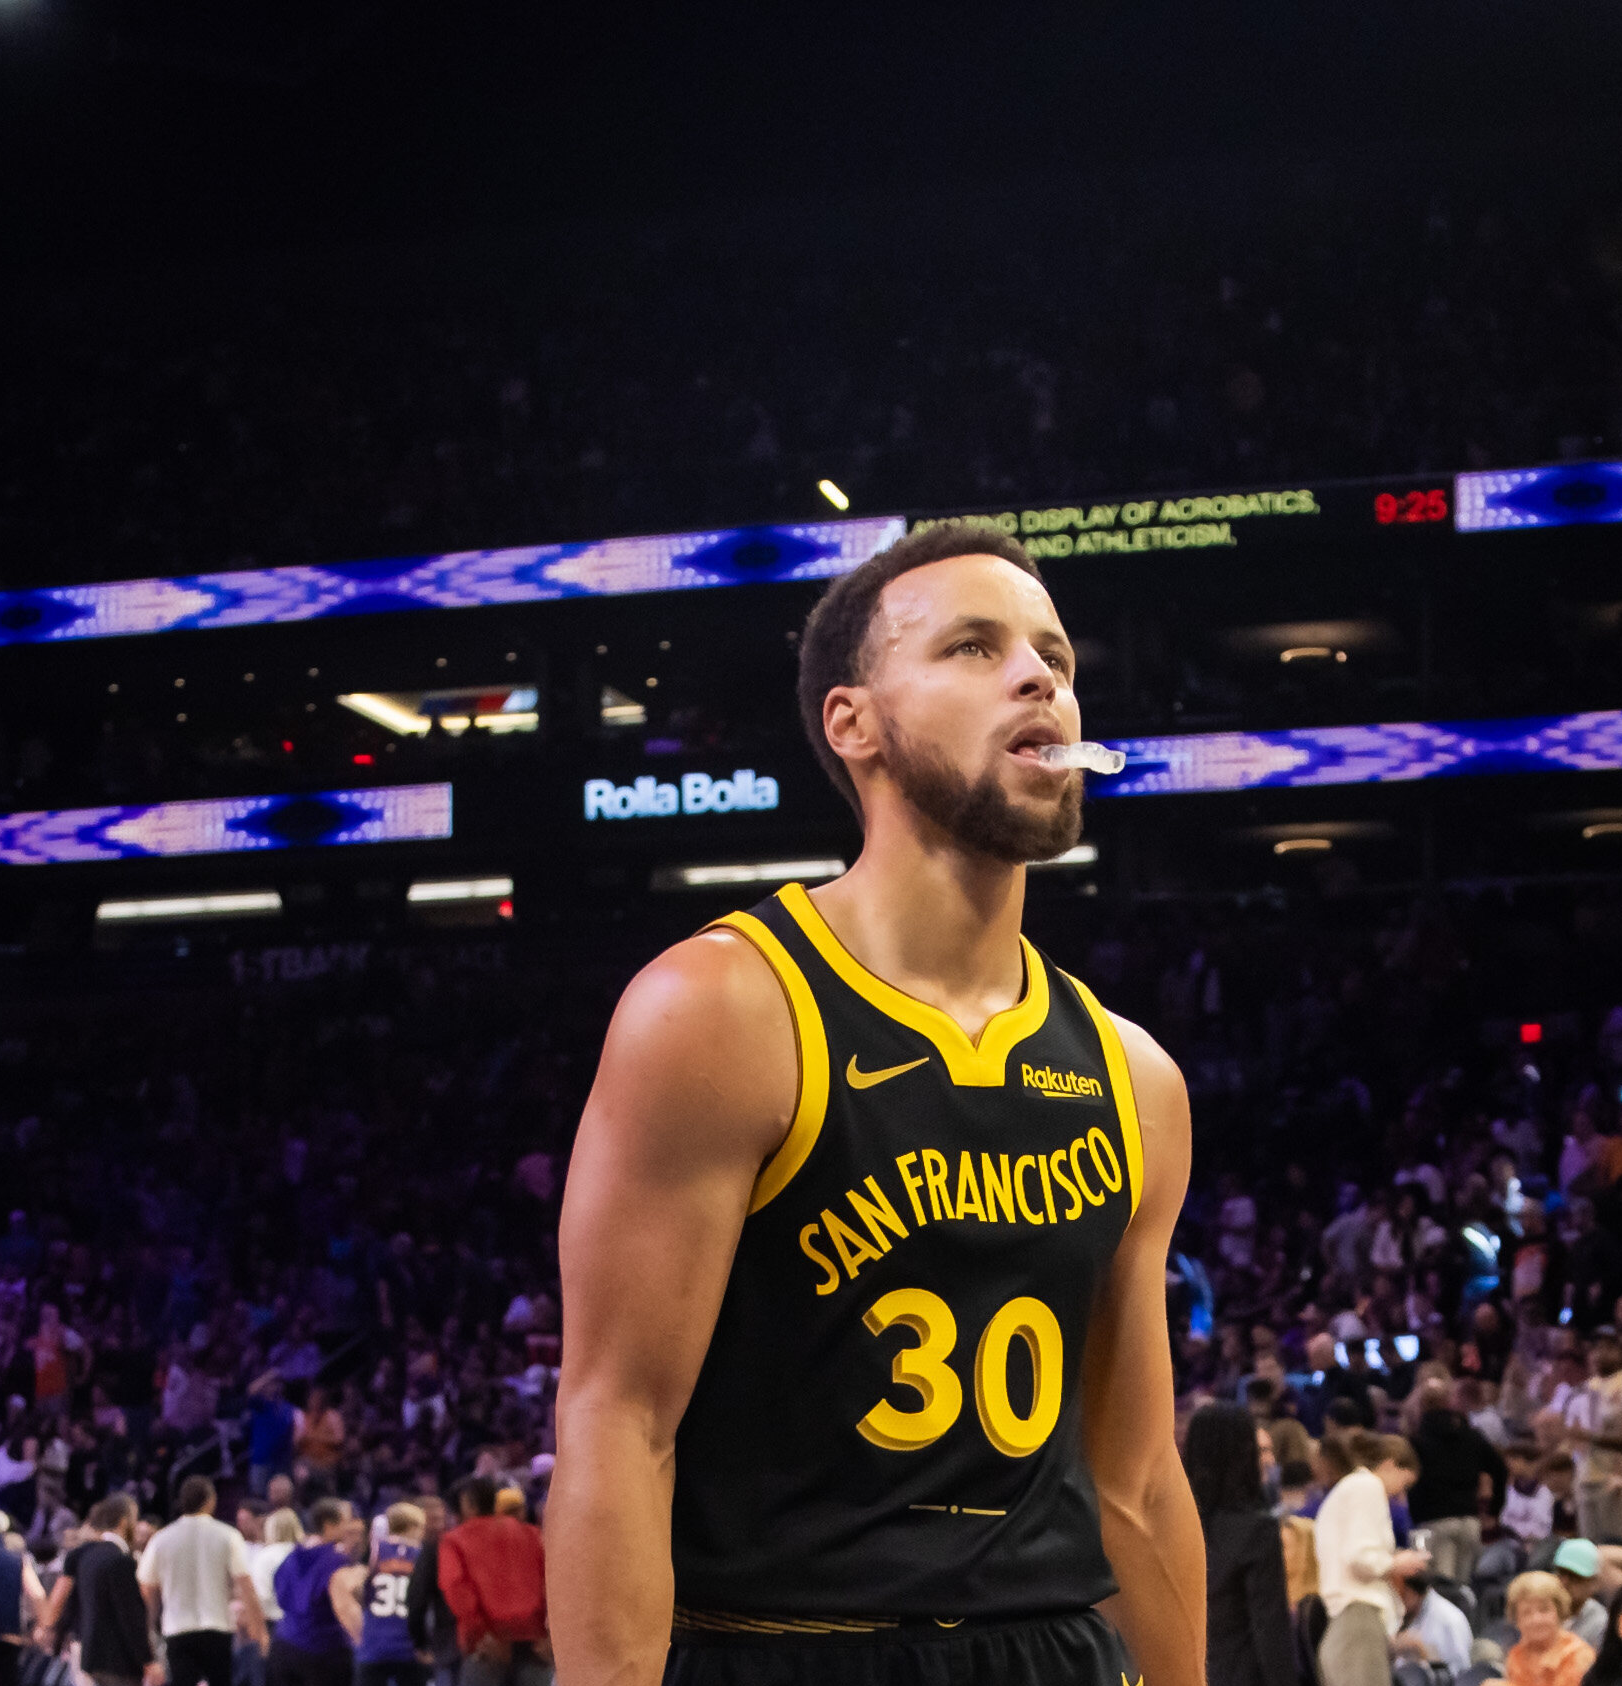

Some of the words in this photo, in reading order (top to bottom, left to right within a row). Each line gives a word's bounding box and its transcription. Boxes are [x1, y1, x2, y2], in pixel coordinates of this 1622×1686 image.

[1020, 503, 1120, 534] DISPLAY
[1121, 499, 1159, 526] OF
[1374, 489, 1448, 525] 9:25
[584, 775, 679, 821] Rolla
[680, 768, 779, 815] Bolla
[1021, 1063, 1103, 1098] Rakuten
[799, 1175, 910, 1296] SAN
[896, 1126, 1123, 1226] FRANCISCO
[856, 1287, 1064, 1458] 30
